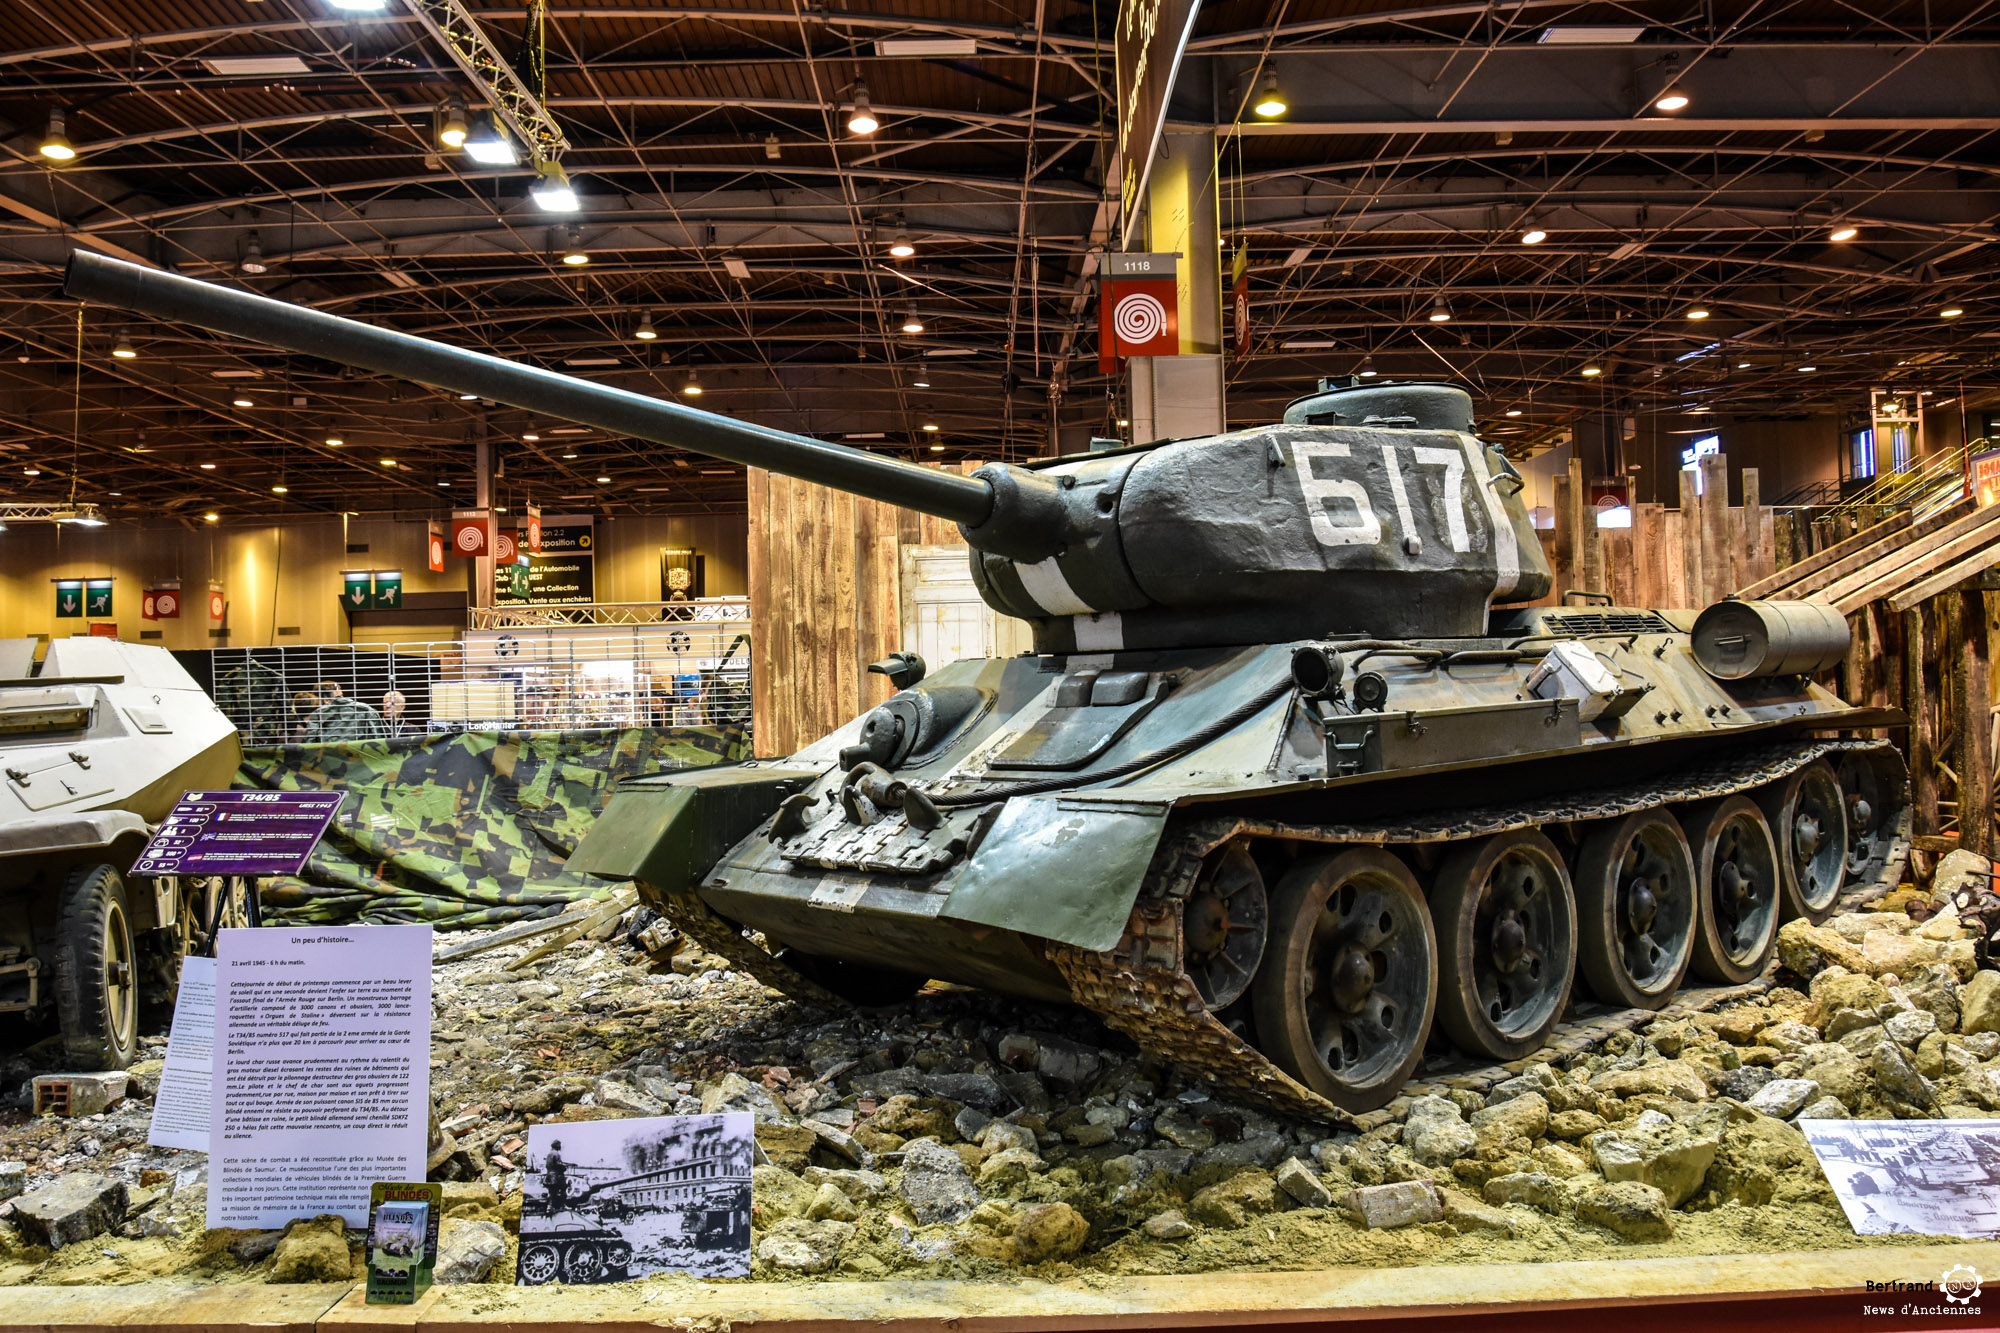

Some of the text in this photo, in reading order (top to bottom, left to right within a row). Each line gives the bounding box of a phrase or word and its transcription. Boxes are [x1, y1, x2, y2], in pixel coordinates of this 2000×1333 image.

[1124, 261, 1150, 272] 1118
[1290, 442, 1470, 552] 617
[540, 539, 575, 548] xposition
